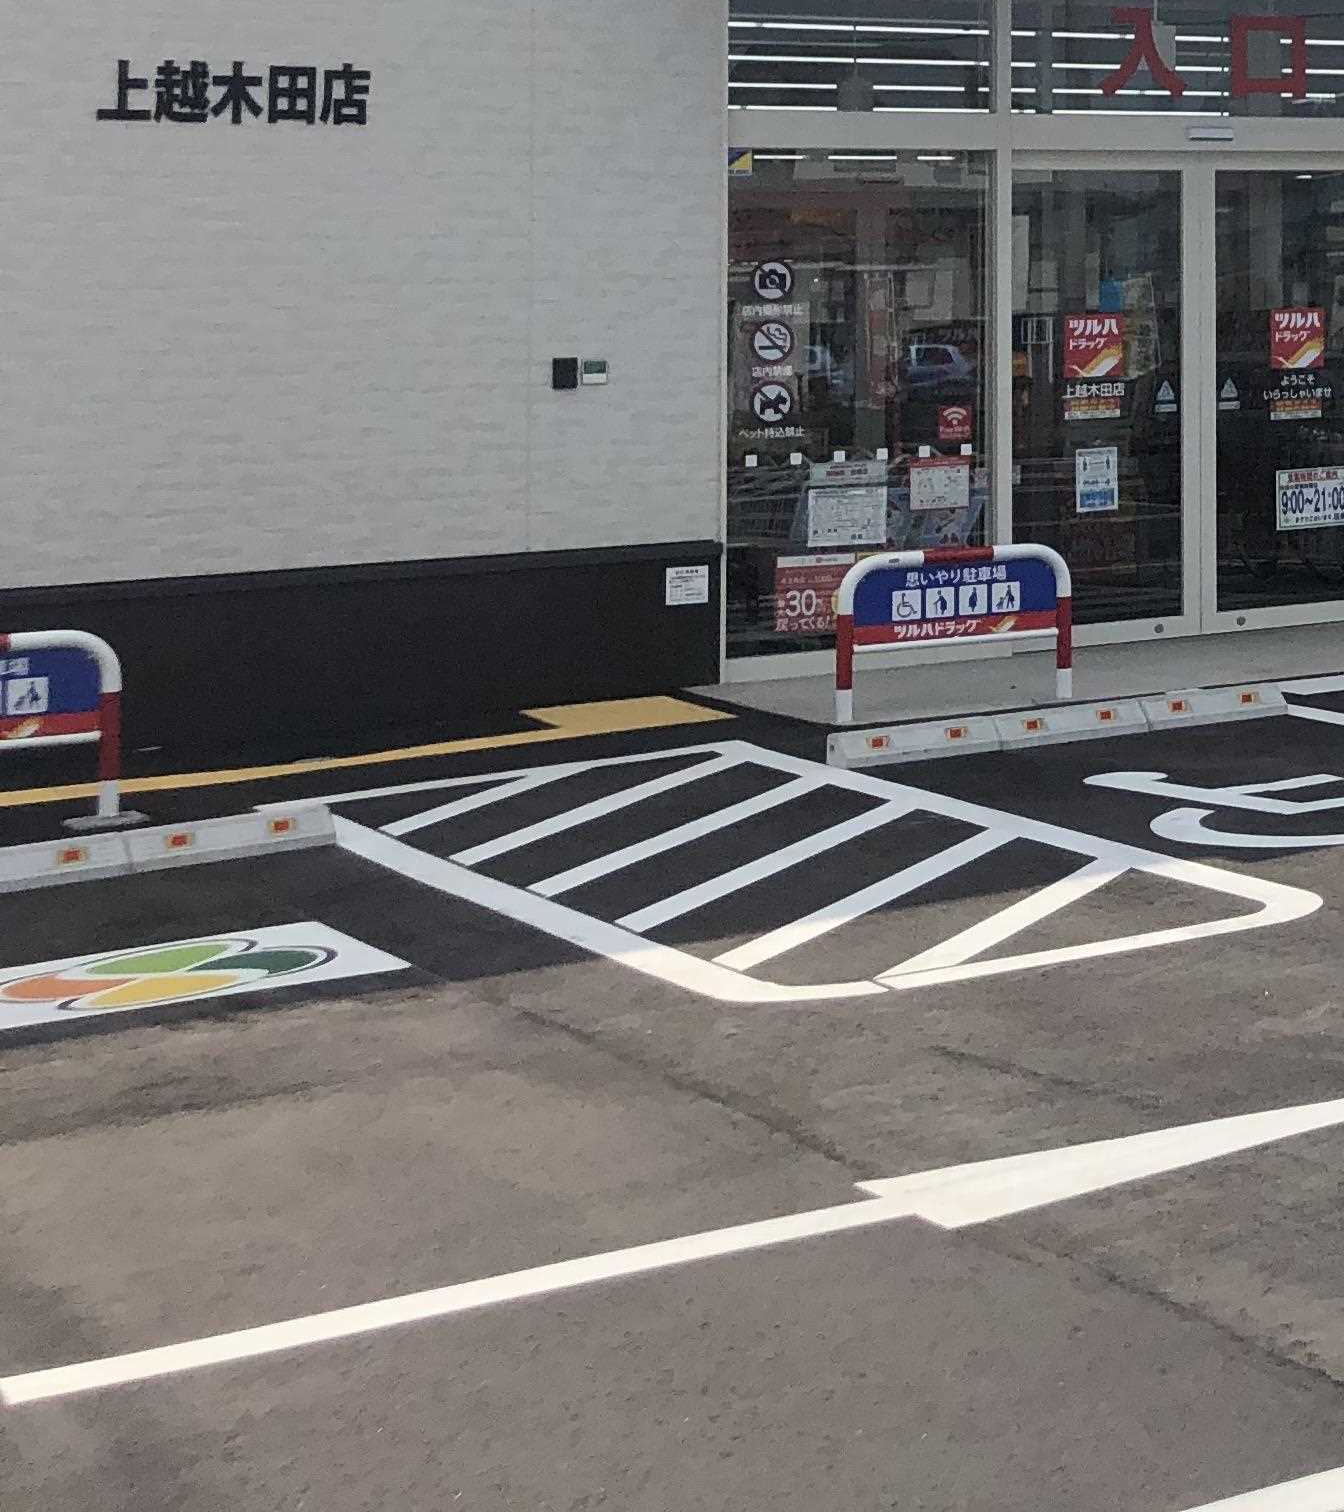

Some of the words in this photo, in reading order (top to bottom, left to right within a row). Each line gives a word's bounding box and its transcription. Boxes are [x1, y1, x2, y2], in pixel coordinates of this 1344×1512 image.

[1101, 6, 1307, 99] 入口
[96, 59, 372, 126] 上越木田店
[1068, 318, 1119, 336] ツルハ
[1274, 312, 1321, 329] ツルハ
[1069, 337, 1108, 351] ドラッグ
[1061, 382, 1125, 399] 上越木田店
[905, 564, 1008, 588] 思いやり駐車場
[785, 588, 817, 617] 30
[893, 619, 981, 639] ツルハドラッグ
